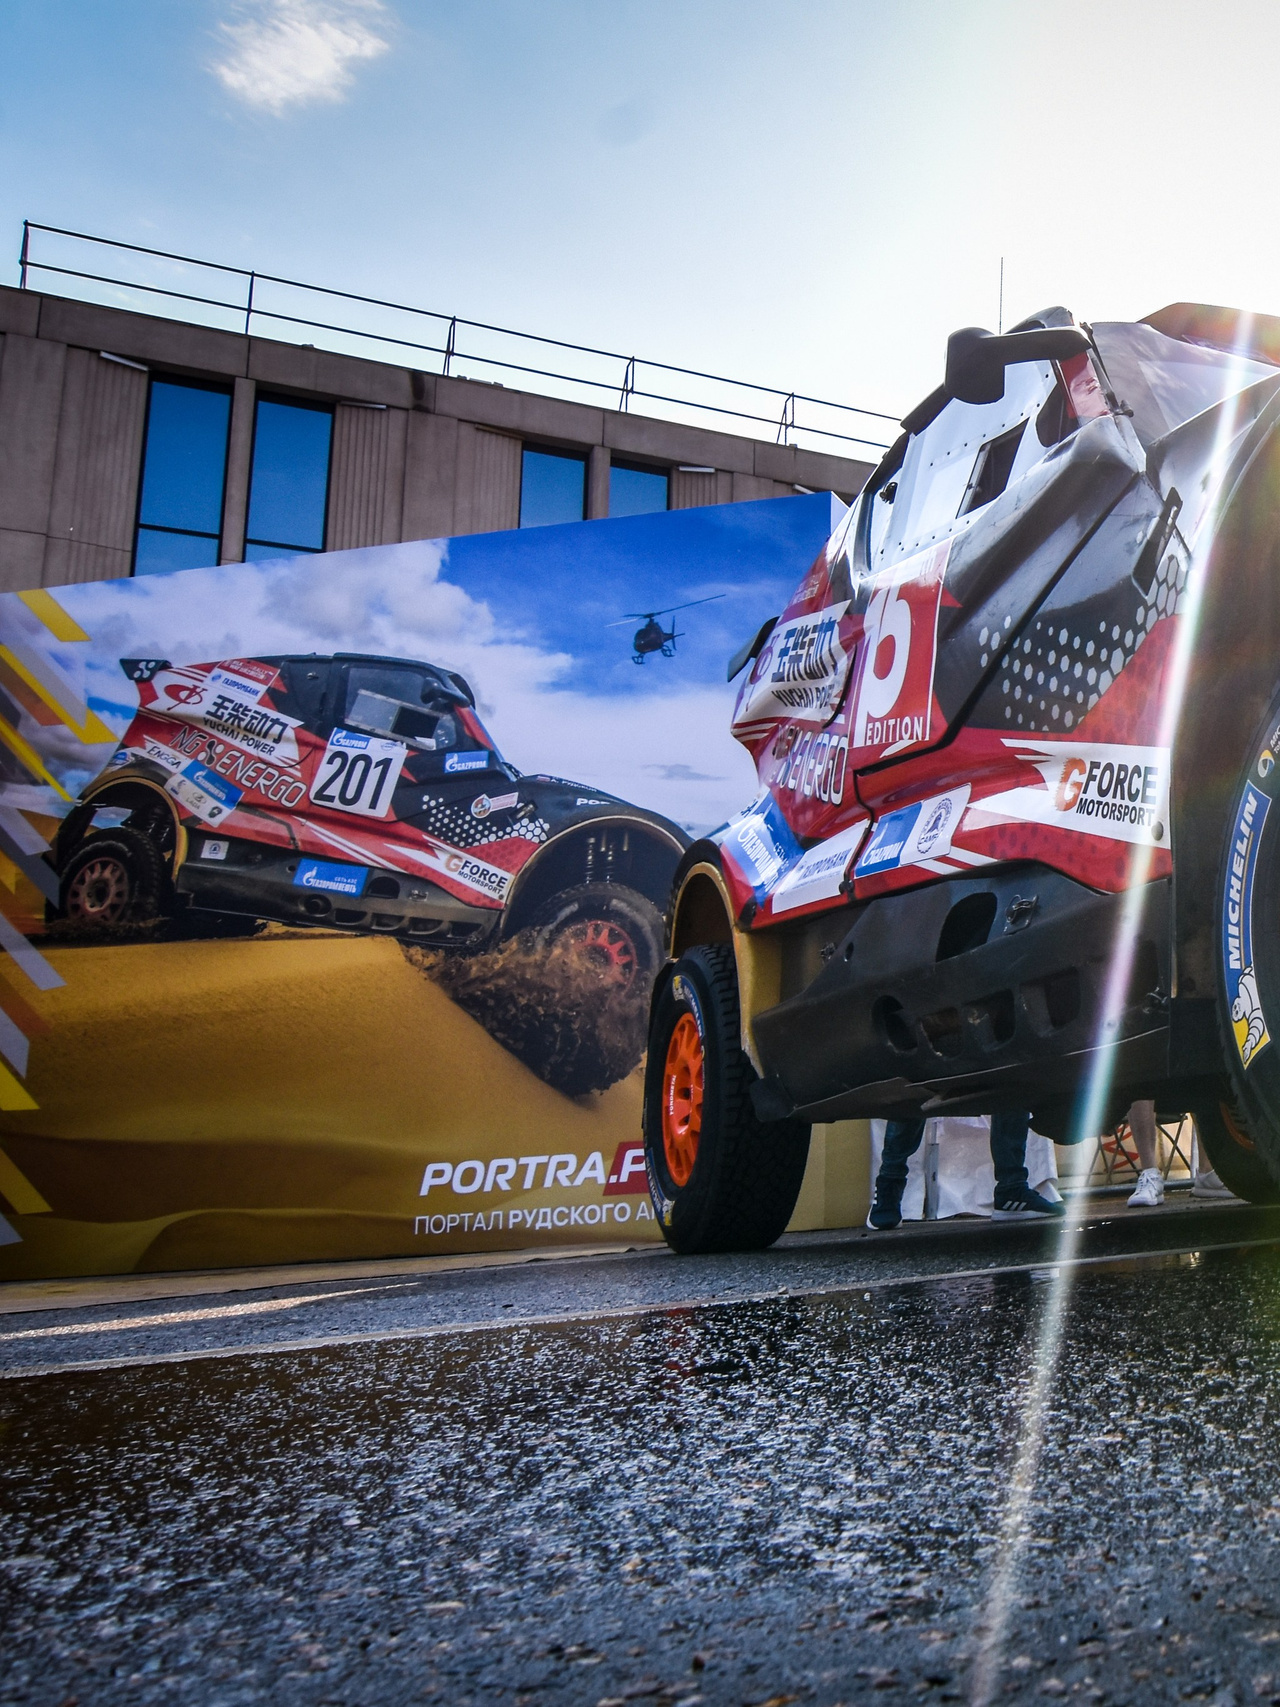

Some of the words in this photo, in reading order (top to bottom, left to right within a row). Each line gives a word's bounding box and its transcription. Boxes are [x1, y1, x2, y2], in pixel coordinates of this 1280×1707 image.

[203, 717, 239, 740] YUCHAI
[240, 735, 276, 756] POWER
[866, 716, 923, 746] EDITION
[170, 725, 208, 756] NG
[215, 750, 307, 808] ENERGO
[313, 750, 394, 810] 201
[1076, 797, 1156, 827] MOTORSPORT
[458, 870, 503, 895] MOTORSPORT
[1228, 793, 1258, 970] MICHELIN
[415, 1210, 503, 1235] ПОРТАЛ
[508, 1202, 632, 1231] РУДСКОГО
